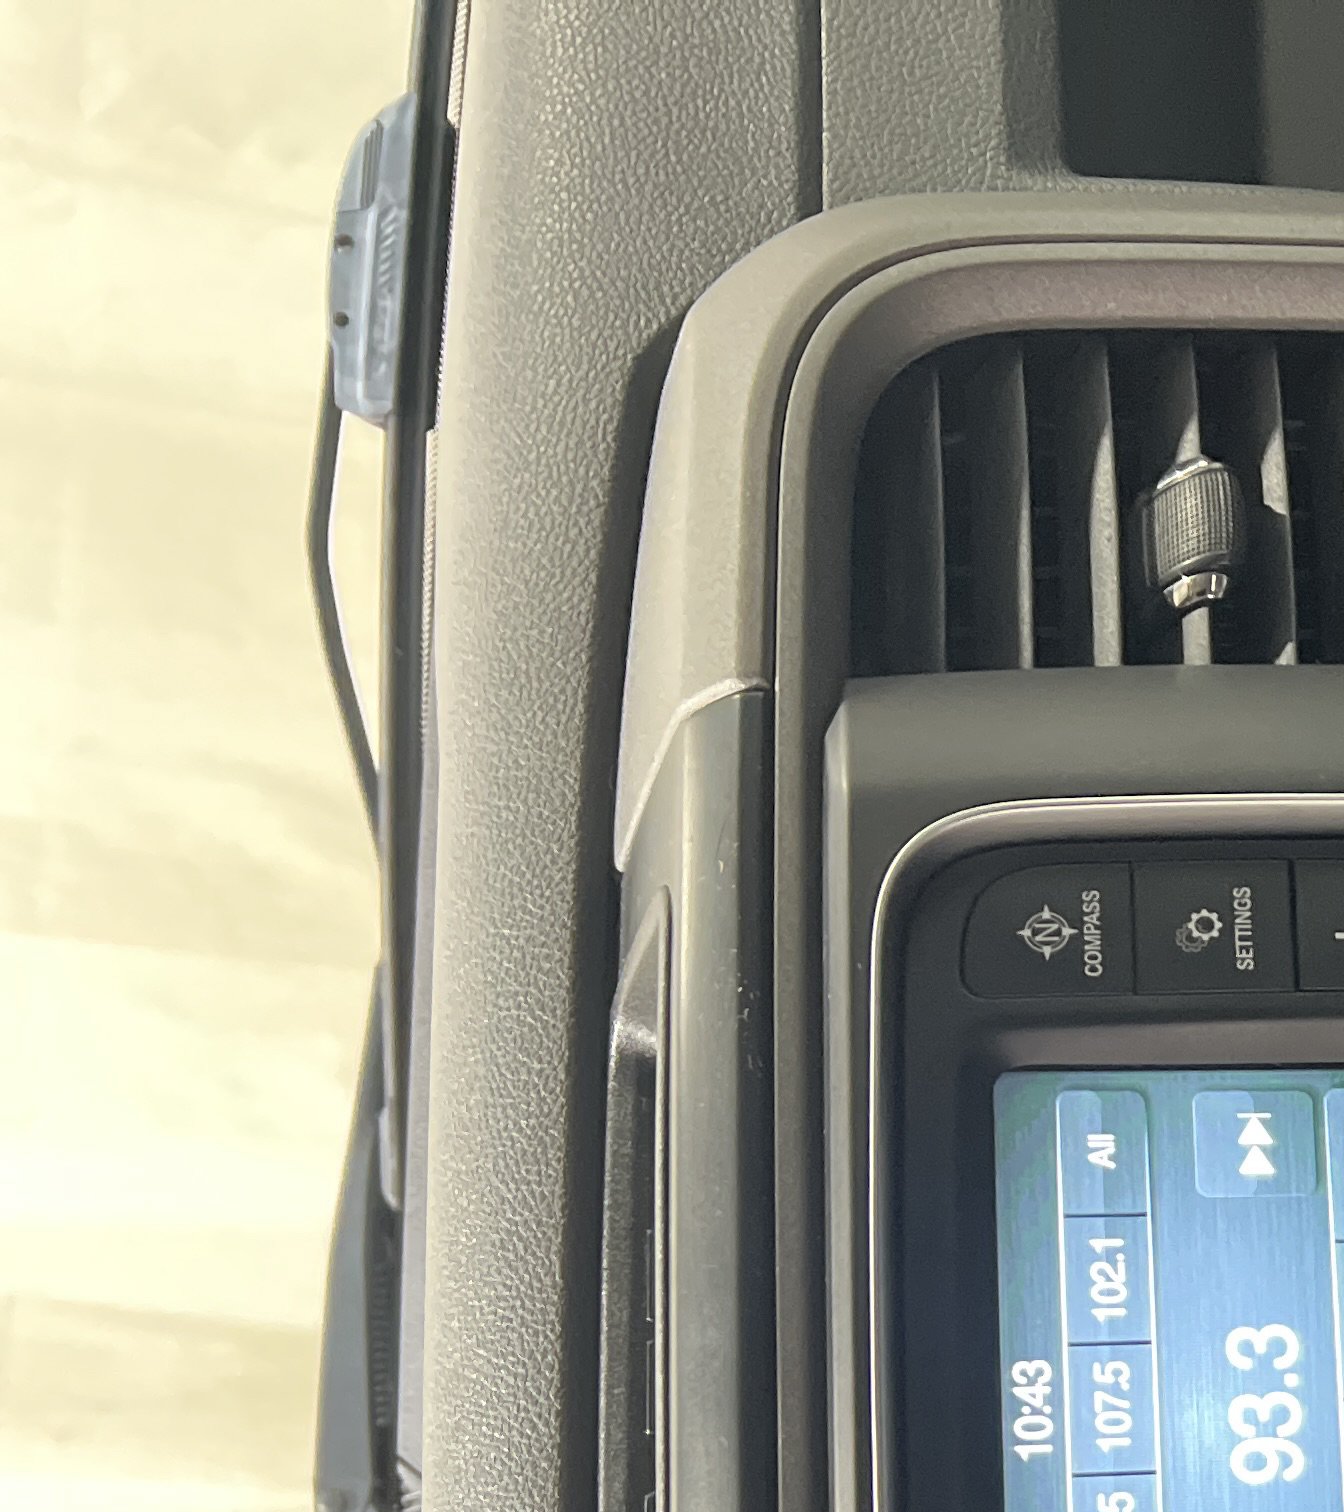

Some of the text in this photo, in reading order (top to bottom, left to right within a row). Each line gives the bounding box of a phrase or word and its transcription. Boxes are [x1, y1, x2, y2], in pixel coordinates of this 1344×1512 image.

[1081, 889, 1103, 977] COMPASS
[1233, 886, 1255, 971] SETTINGS
[1086, 1134, 1117, 1170] All
[1088, 1237, 1128, 1322] 102.1
[1010, 1359, 1054, 1462] 10:43
[1092, 1360, 1133, 1453] 107.5
[1225, 1323, 1305, 1485] 93.3
